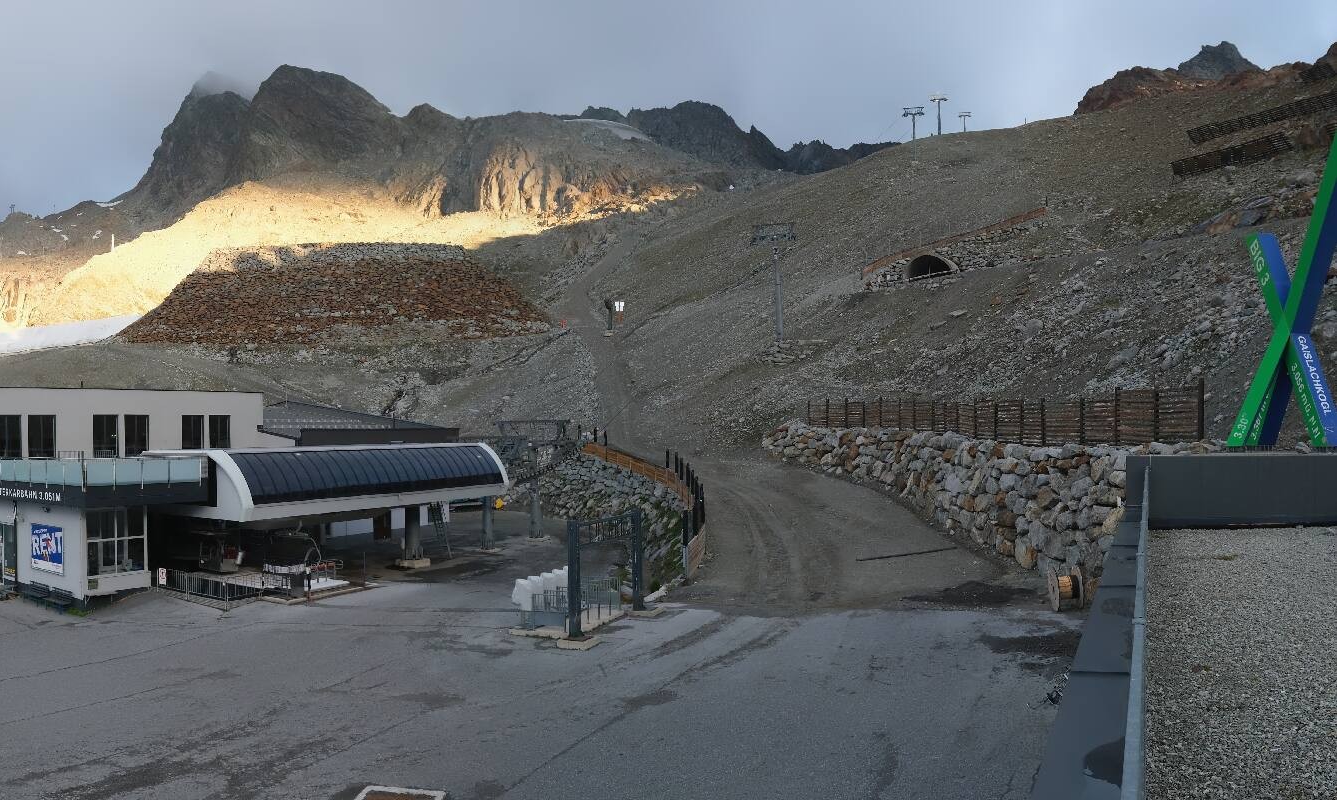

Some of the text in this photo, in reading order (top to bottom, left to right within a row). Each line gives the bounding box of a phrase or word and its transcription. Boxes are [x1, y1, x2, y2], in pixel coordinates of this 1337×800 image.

[1250, 239, 1270, 286] BIG 3
[1297, 335, 1332, 415] GAISLACHKOGL
[31, 532, 63, 556] RENT
